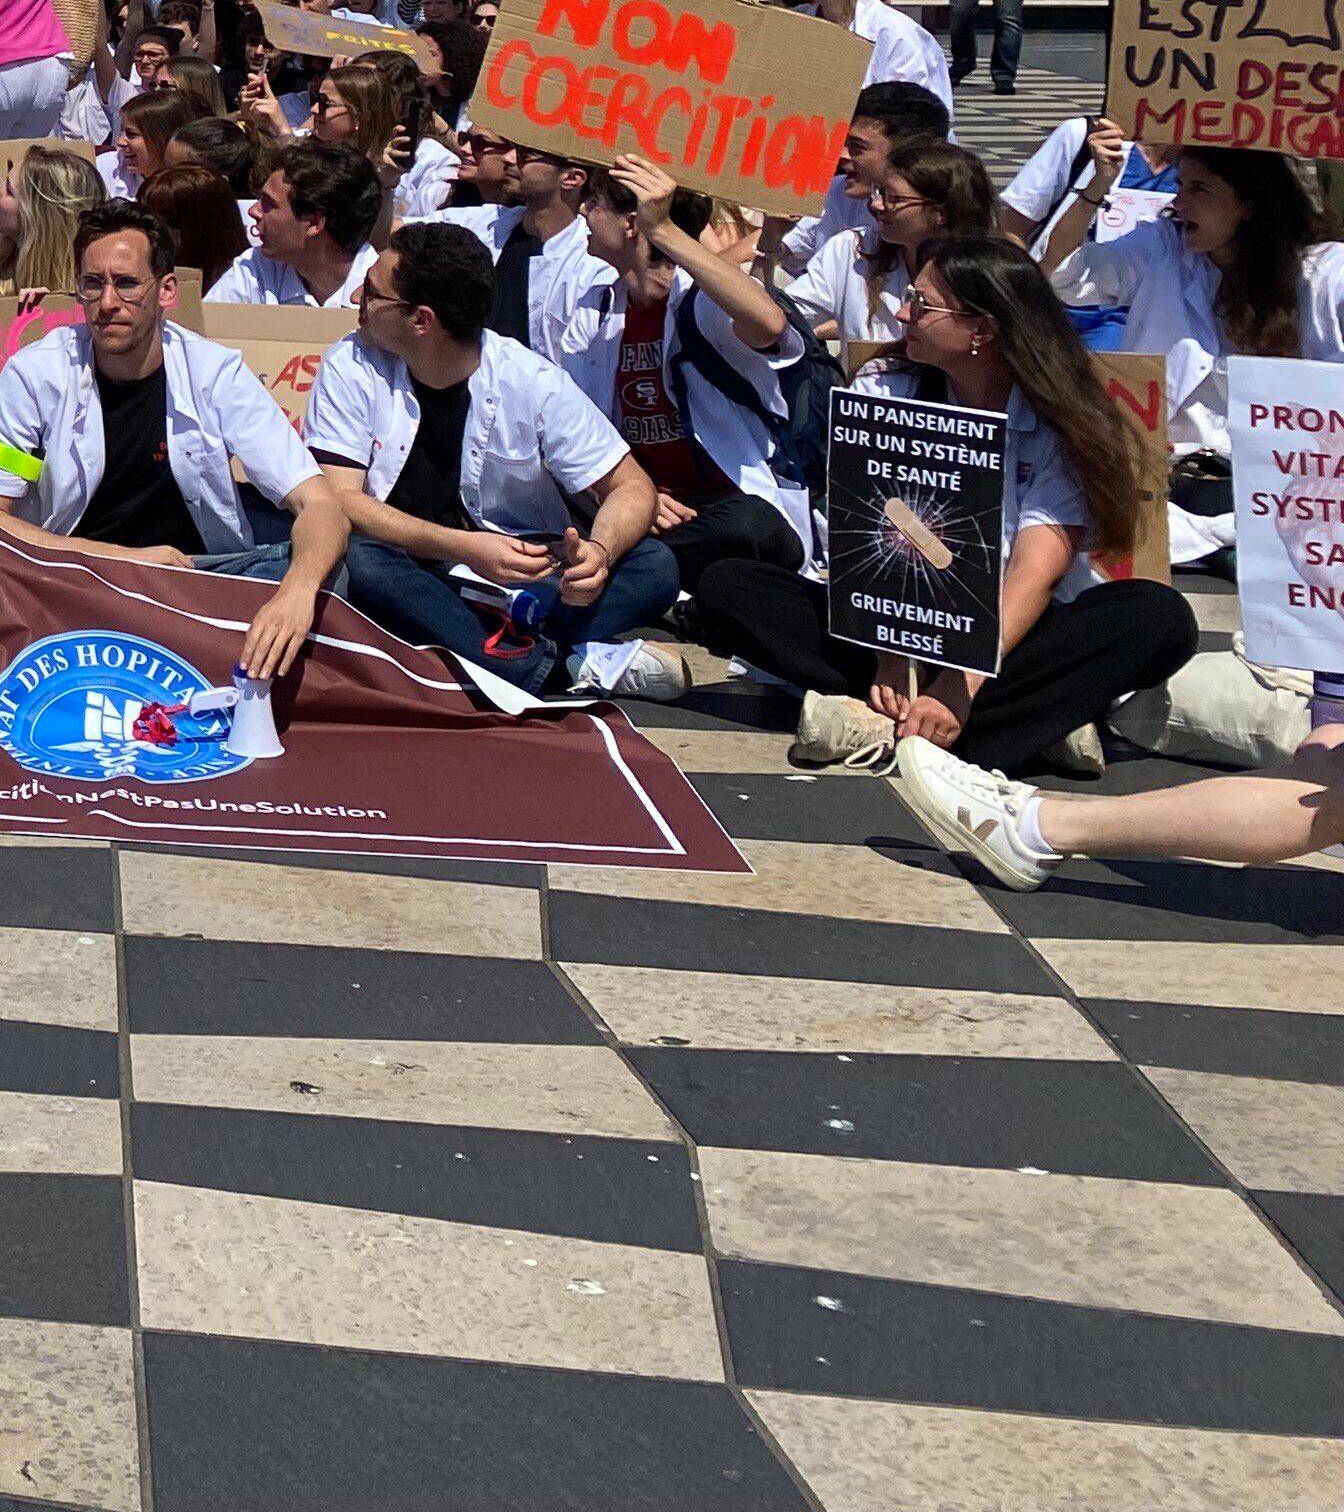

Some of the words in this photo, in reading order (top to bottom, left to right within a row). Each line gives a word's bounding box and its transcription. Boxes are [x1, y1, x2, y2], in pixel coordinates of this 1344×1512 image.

[1125, 45, 1218, 92] UN
[839, 399, 868, 420] UN
[873, 405, 998, 441] PANSEMENT
[833, 425, 870, 448] SUR
[875, 432, 906, 454] UN
[909, 439, 1002, 471] SYSTÈME
[866, 459, 893, 479] DE
[896, 464, 962, 492] SANTÉ
[850, 591, 976, 634] GRIEVEMENT
[875, 624, 944, 655] BLESSÉ
[16, 647, 69, 694] DES
